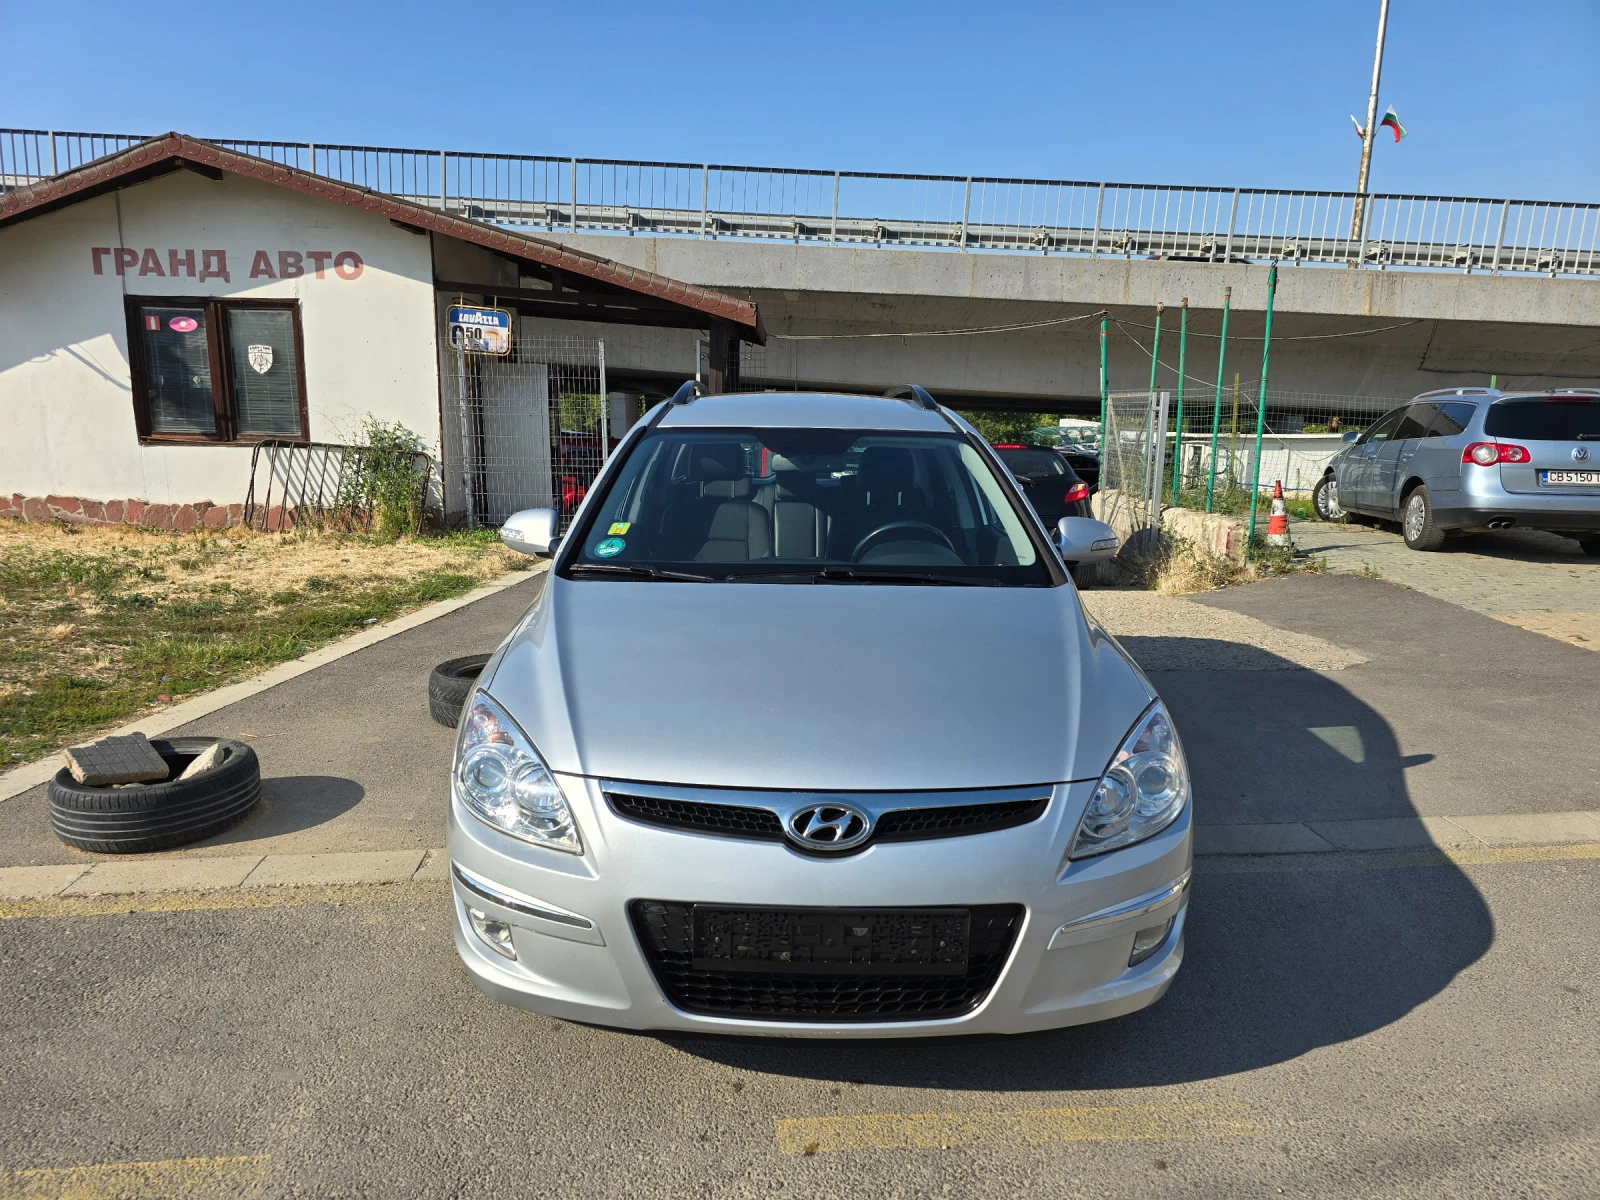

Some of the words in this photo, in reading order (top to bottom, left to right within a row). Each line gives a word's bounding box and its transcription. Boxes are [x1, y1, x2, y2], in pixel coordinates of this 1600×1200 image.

[91, 247, 230, 283] ГРАНД
[249, 250, 364, 281] АВТО
[458, 311, 500, 326] LAVAZZA
[1550, 472, 1564, 482] CB
[1567, 472, 1592, 482] 5150
